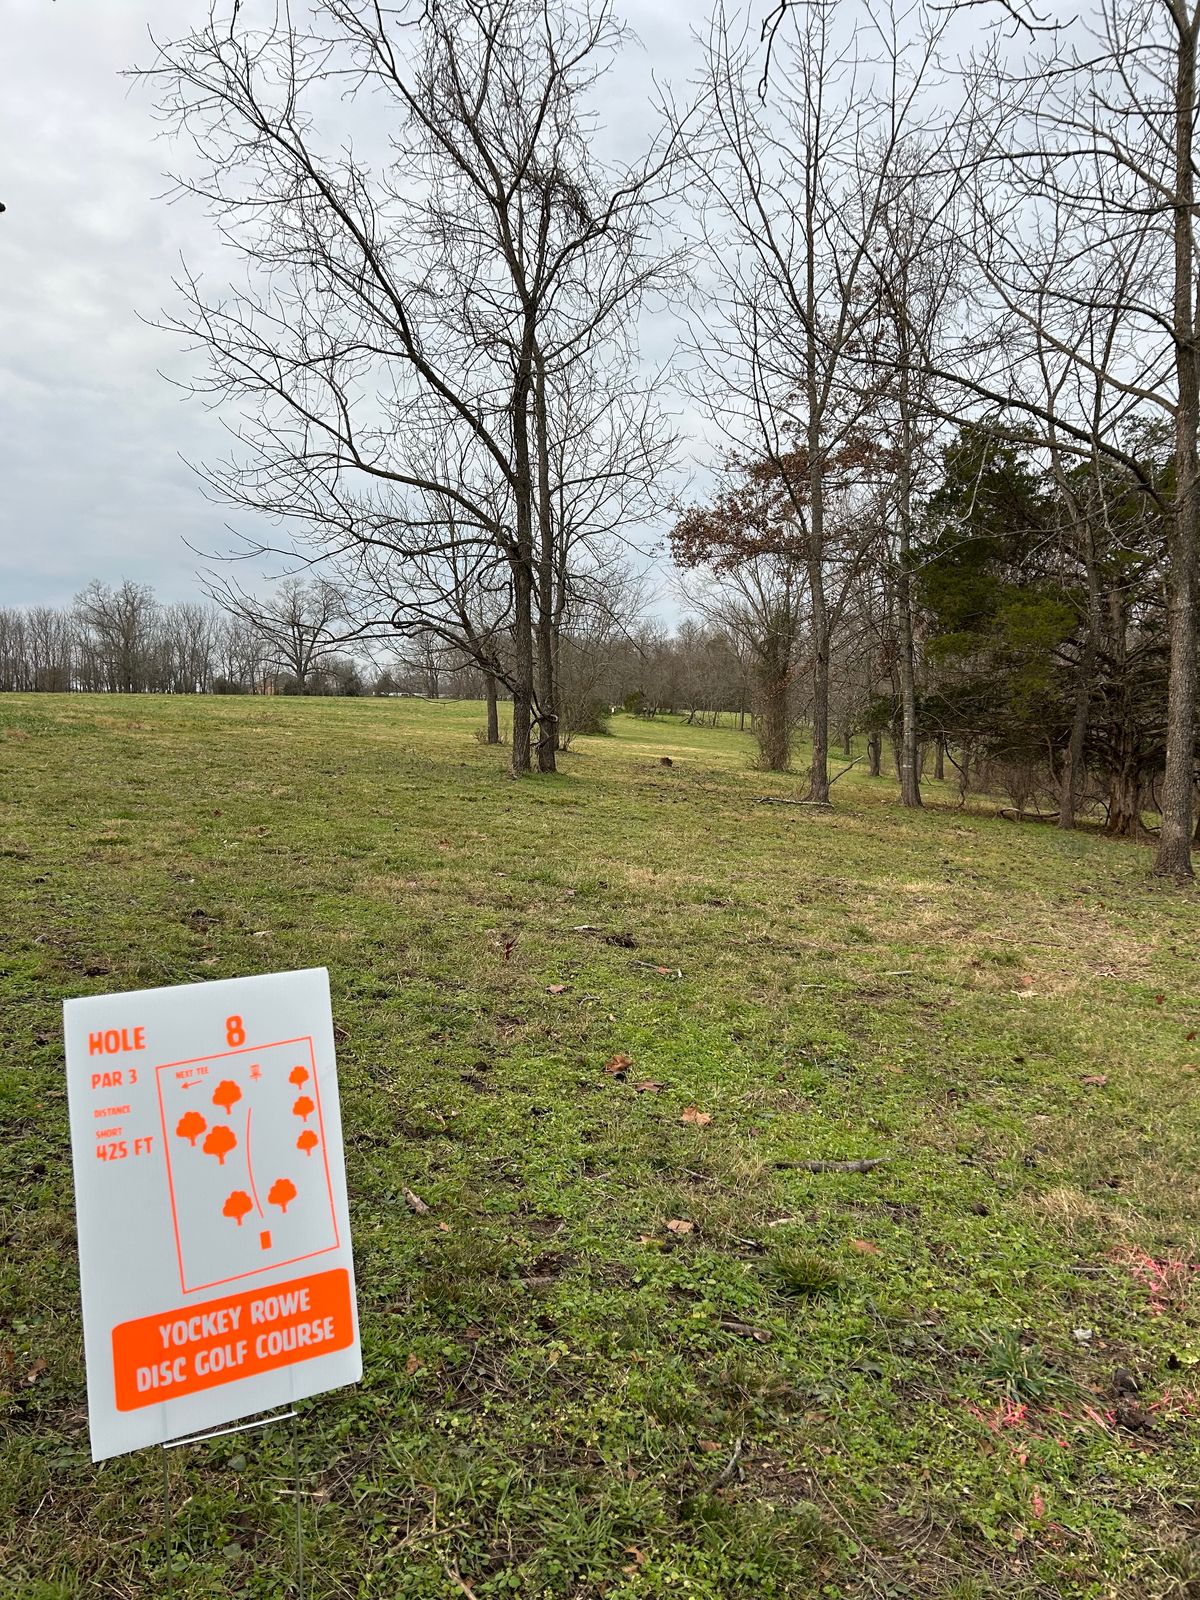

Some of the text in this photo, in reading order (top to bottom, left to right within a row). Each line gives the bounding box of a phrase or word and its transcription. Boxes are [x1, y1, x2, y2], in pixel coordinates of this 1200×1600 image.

[88, 1015, 246, 1056] HOLE 8
[91, 1068, 138, 1090] PAR 3
[175, 1066, 209, 1080] NEXT TEE
[93, 1105, 131, 1119] DISTANCE
[96, 1127, 123, 1139] SHORT
[96, 1136, 153, 1162] 425 FT
[159, 1288, 311, 1349] YOCKEY ROWE
[136, 1316, 335, 1393] DISC GOLF COURSE
